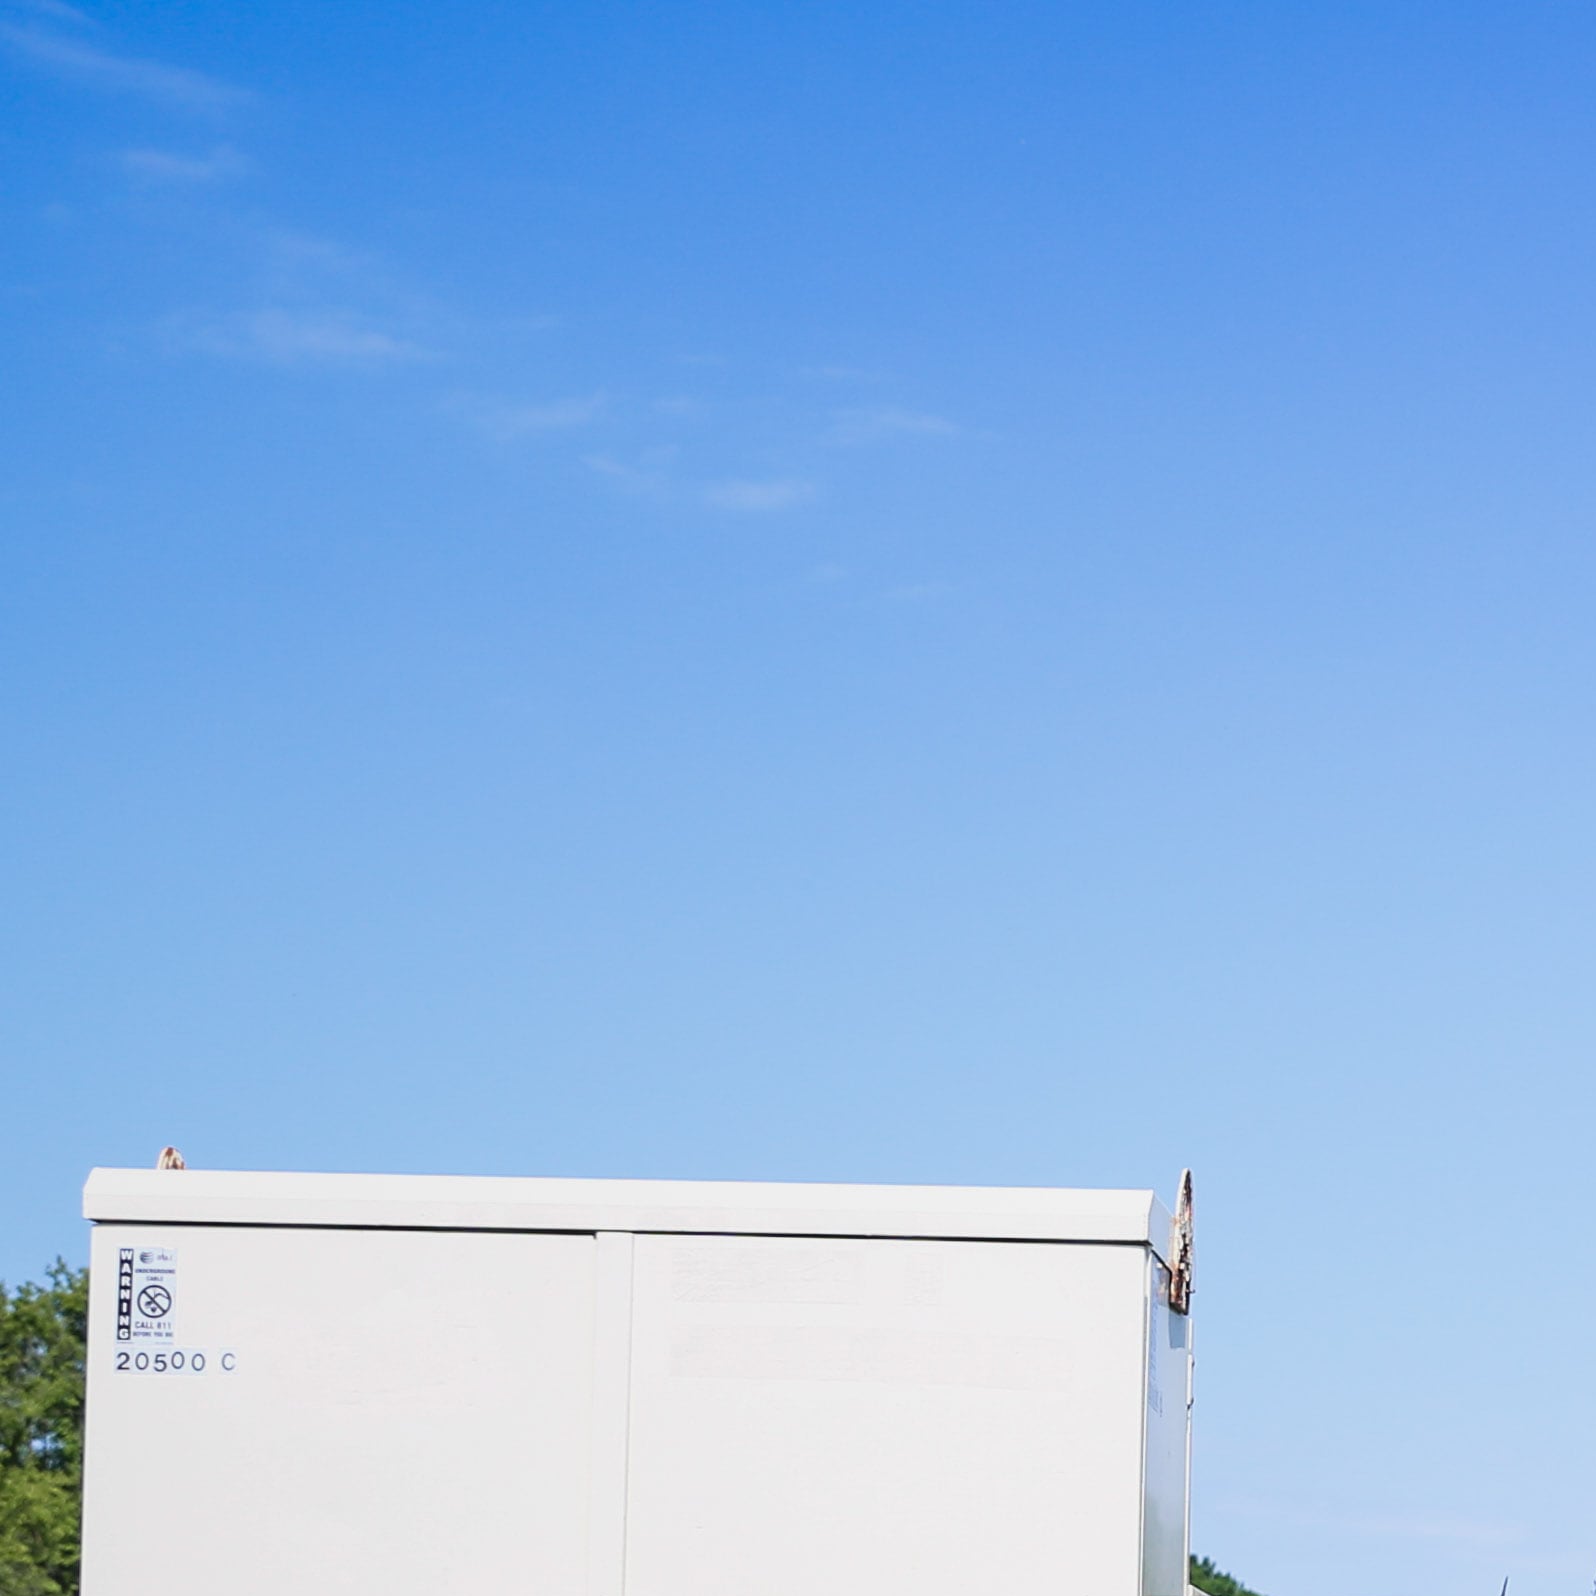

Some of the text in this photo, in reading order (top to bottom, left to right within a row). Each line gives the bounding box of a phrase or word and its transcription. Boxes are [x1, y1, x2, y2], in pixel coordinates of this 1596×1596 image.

[118, 1249, 133, 1339] WARNING
[135, 1321, 154, 1329] CALL
[116, 1351, 236, 1373] 20500 C
